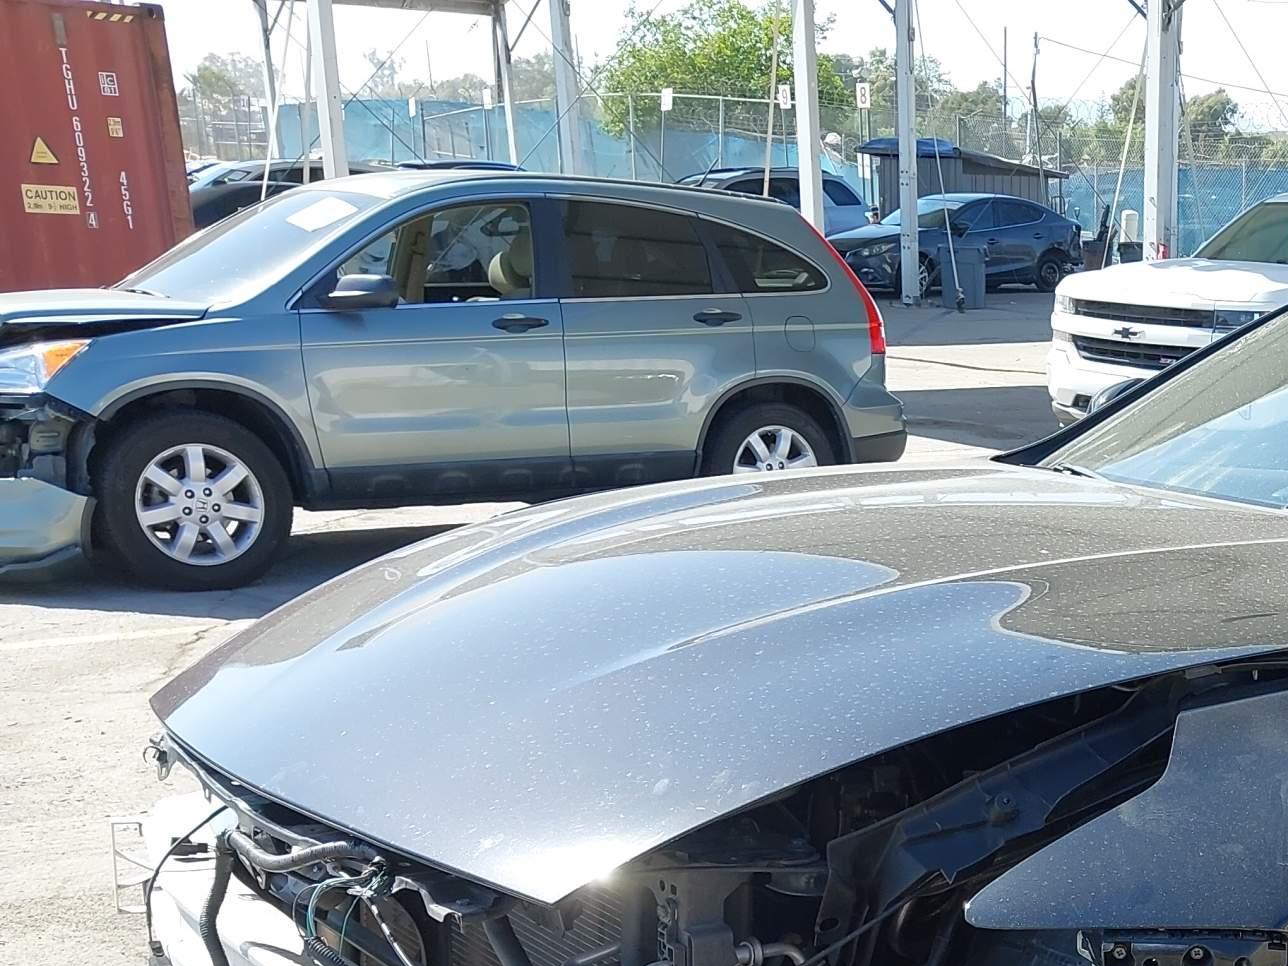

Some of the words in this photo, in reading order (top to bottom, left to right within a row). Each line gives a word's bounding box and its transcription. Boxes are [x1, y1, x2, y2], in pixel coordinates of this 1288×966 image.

[782, 88, 788, 105] 9
[859, 86, 867, 105] 8
[59, 47, 78, 111] TGHU
[72, 116, 94, 207] 609322
[25, 188, 76, 201] CAUTION
[120, 171, 134, 230] 45G1
